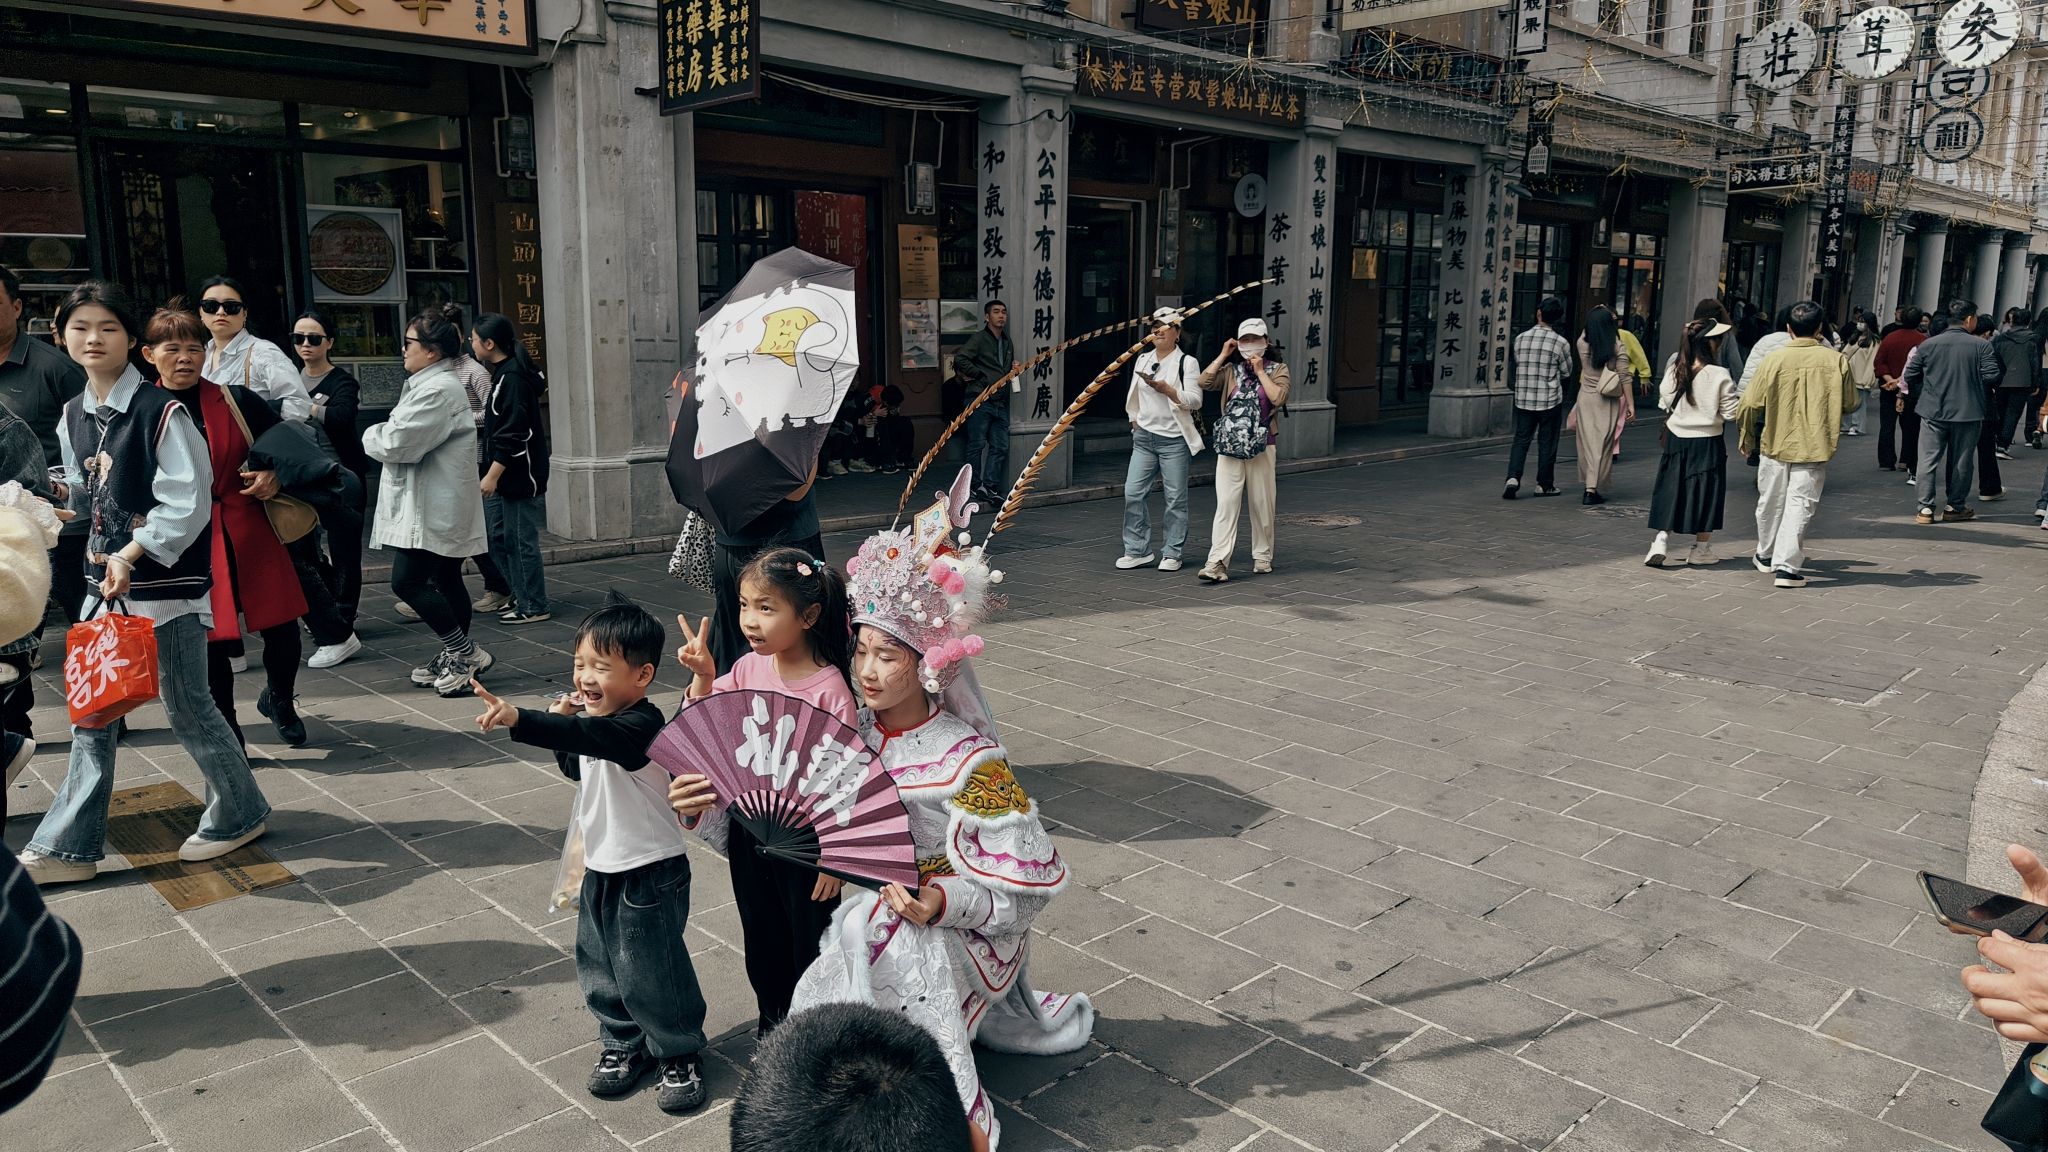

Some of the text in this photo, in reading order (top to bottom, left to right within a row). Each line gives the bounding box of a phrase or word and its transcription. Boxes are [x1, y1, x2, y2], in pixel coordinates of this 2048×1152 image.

[474, 0, 487, 34] 藥材
[741, 0, 750, 80] 辦中西各
